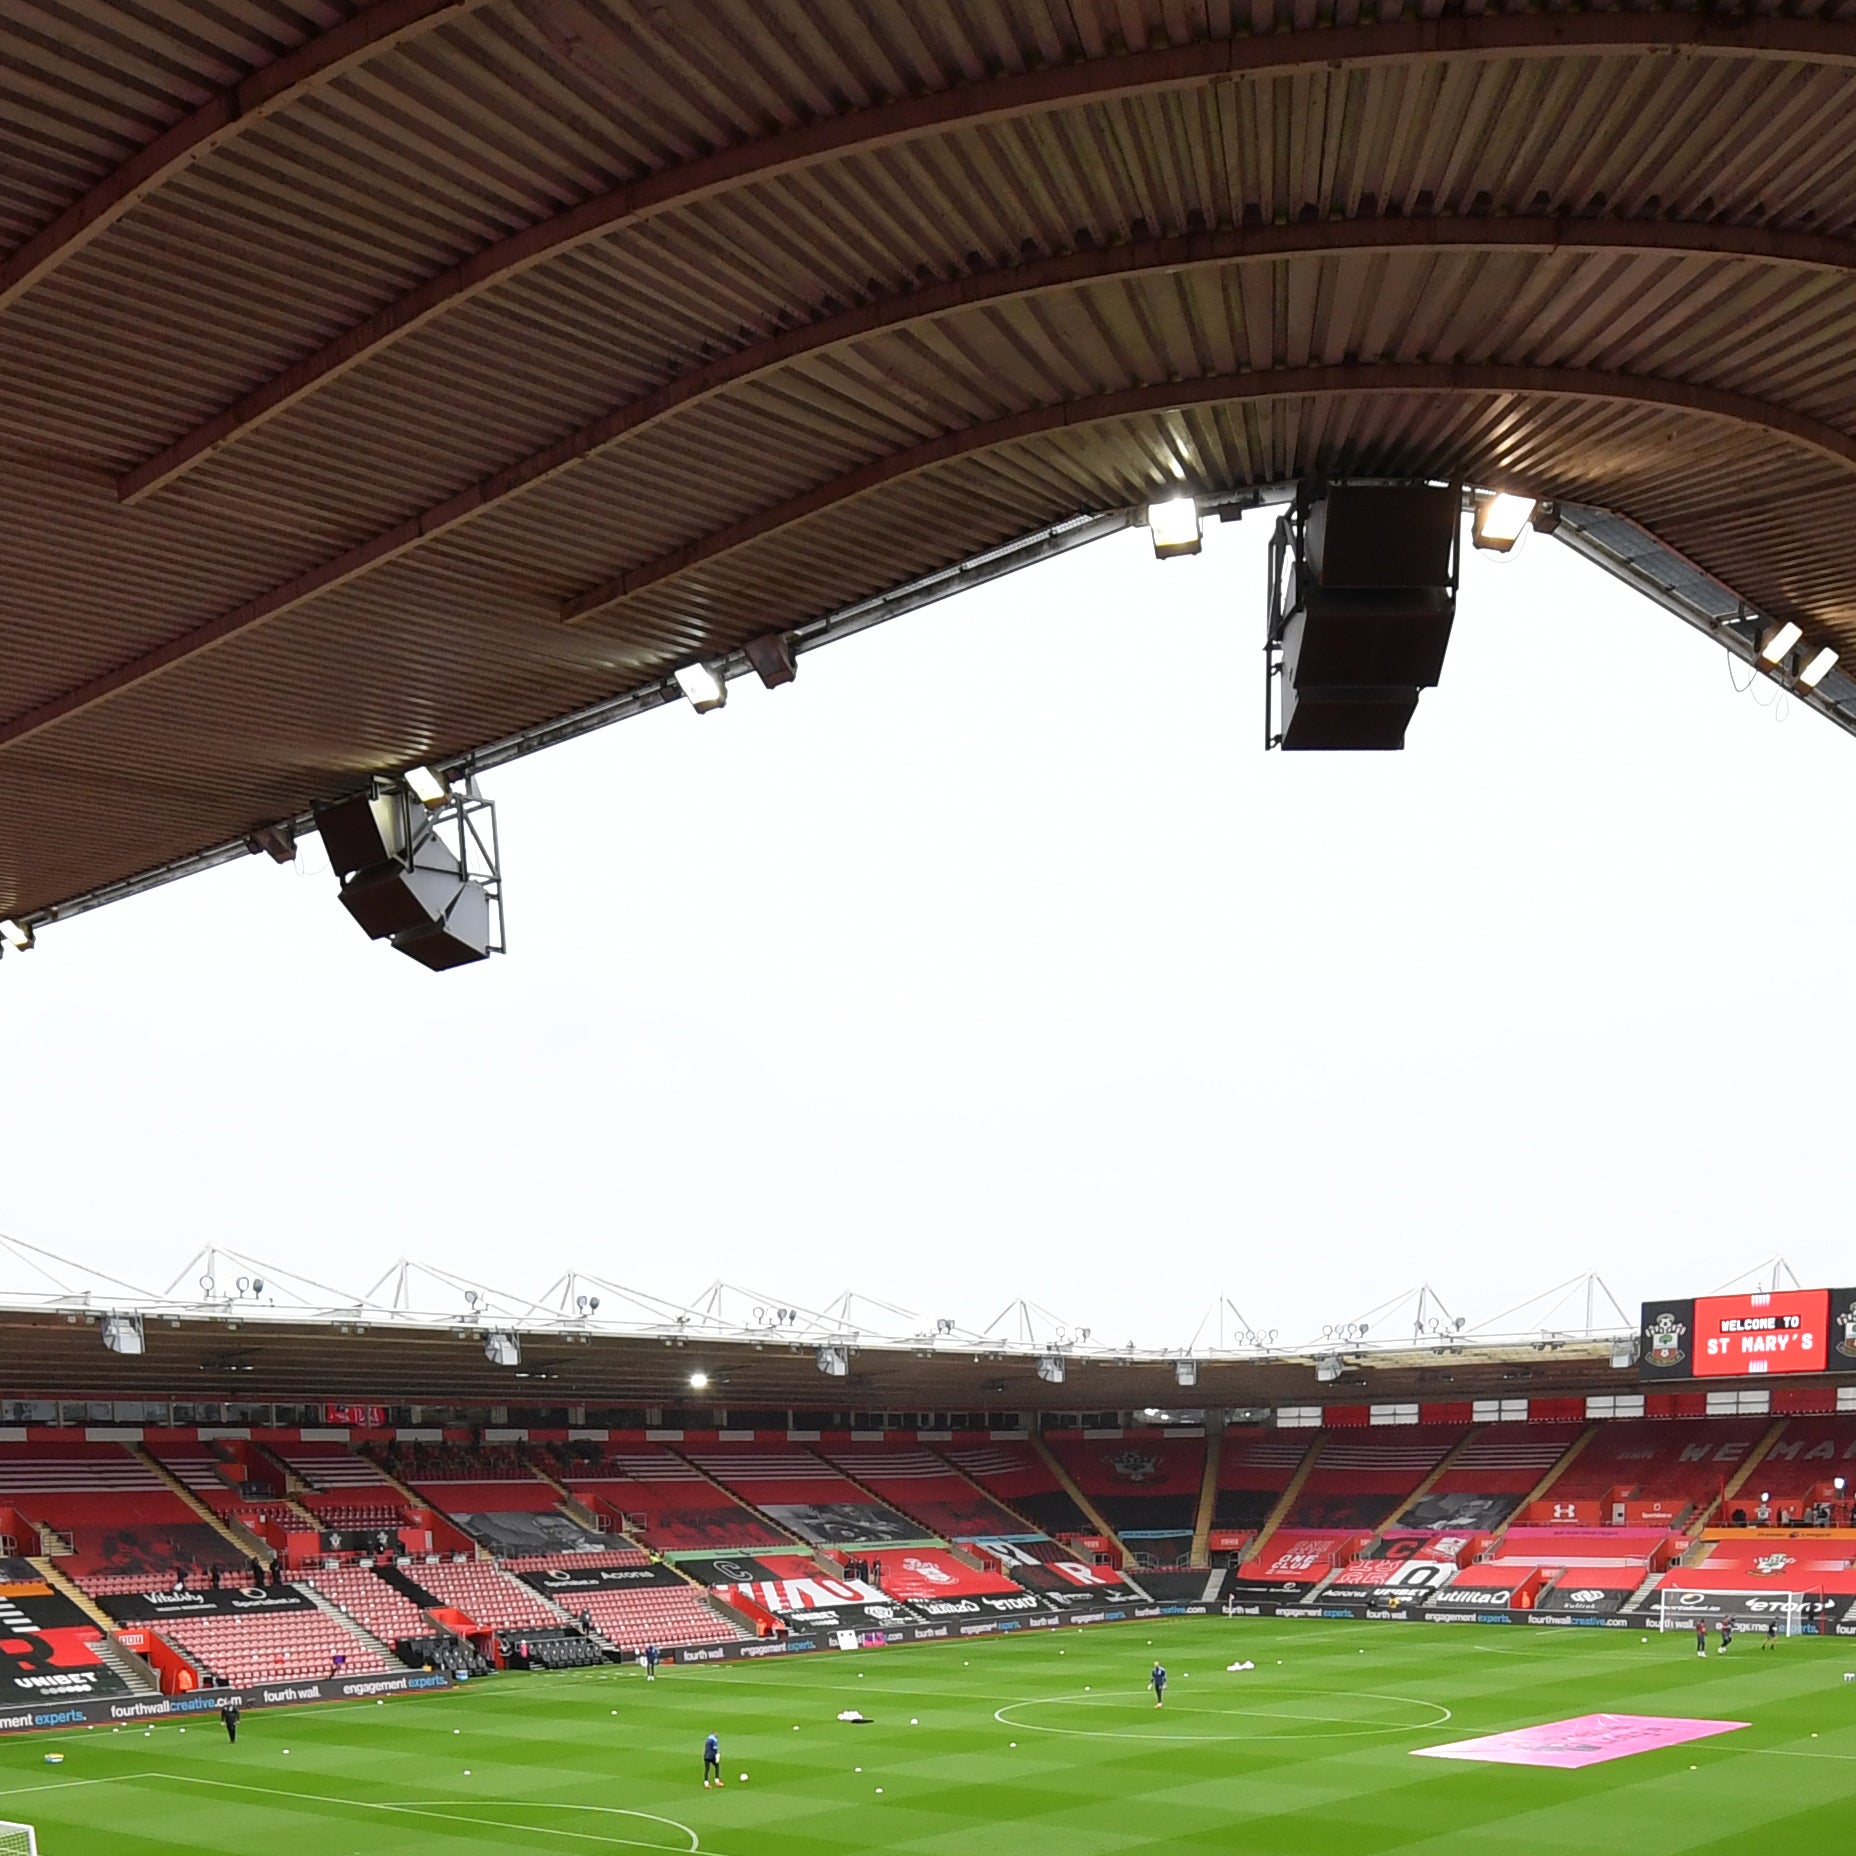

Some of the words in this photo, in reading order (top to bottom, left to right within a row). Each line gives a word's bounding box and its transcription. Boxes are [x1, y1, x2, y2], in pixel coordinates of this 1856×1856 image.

[1722, 1318, 1776, 1331] WELCOME
[1782, 1316, 1800, 1328] TO
[1707, 1336, 1731, 1355] ST
[1741, 1333, 1813, 1353] MARY'S
[1679, 1441, 1751, 1463] WE
[1278, 1555, 1318, 1564] ONE
[600, 1569, 655, 1580] Acronis
[144, 1589, 205, 1606] Vitality
[1322, 1589, 1367, 1598] Acronis
[1374, 1588, 1430, 1597] UNIBET
[1438, 1591, 1492, 1603] utilita
[1222, 1604, 1243, 1615] fourth
[1275, 1607, 1322, 1618] engagement
[1323, 1608, 1354, 1619] experts.
[1366, 1608, 1388, 1620] fourth
[1029, 1617, 1044, 1627] fourth
[1070, 1612, 1105, 1625] engagement
[1424, 1612, 1477, 1624] engagement
[1478, 1613, 1512, 1625] experts.
[1528, 1614, 1628, 1628] fourthwallcreative.com
[914, 1628, 932, 1639] fourth
[960, 1623, 998, 1636] engagement
[740, 1641, 787, 1657] engagement
[787, 1639, 817, 1651] experts.
[683, 1649, 707, 1661] fourth
[14, 1671, 98, 1690] UNIBET
[343, 1678, 408, 1696] engagement
[408, 1675, 447, 1688] experts.
[263, 1688, 295, 1702] fourth
[35, 1709, 87, 1727] experts.
